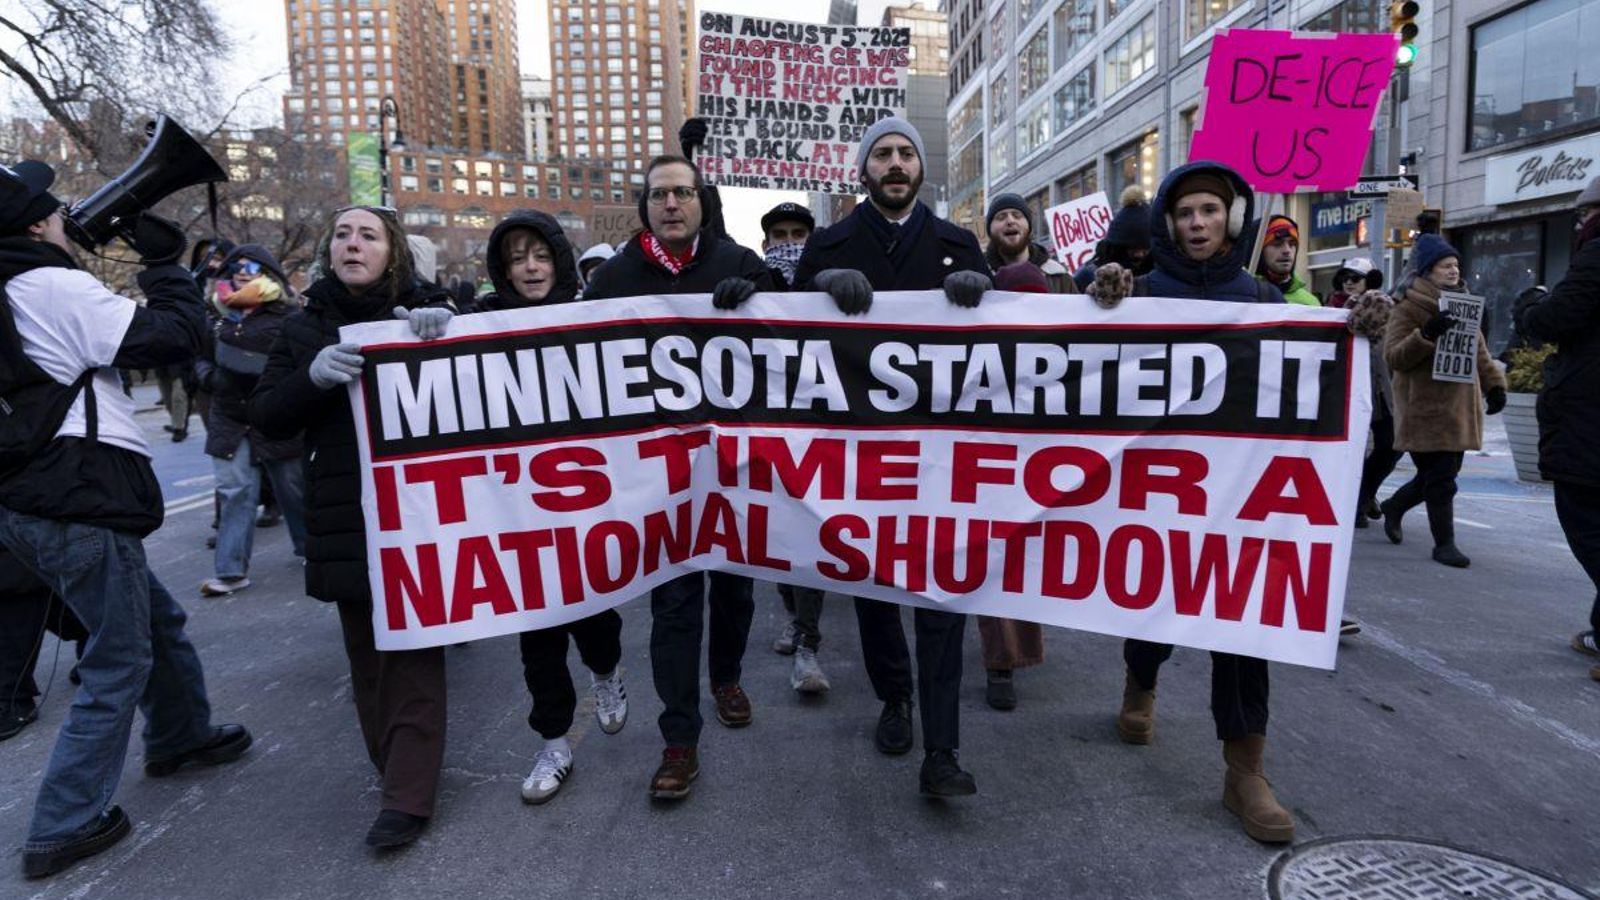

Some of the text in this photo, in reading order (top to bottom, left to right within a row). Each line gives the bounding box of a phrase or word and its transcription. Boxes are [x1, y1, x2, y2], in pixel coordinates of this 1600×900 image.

[701, 12, 733, 34] ON
[740, 17, 838, 45] AUGUST
[700, 34, 825, 66] CHAOFENG
[866, 47, 911, 68] WAS
[700, 53, 898, 87] FOUND HANGING
[1230, 53, 1387, 109] DE-ICE
[700, 72, 725, 95] BY
[729, 74, 777, 98] THE
[851, 87, 906, 109] WITH
[699, 94, 738, 118] HIS
[745, 98, 830, 123] HANDS
[756, 119, 836, 141] BOUND
[697, 136, 739, 159] HIS
[811, 143, 849, 165] AT
[1253, 127, 1329, 180] US
[697, 155, 724, 174] ICE
[731, 156, 845, 182] DETENTION
[704, 173, 769, 189] LAIMING
[773, 177, 833, 193] THAT'S
[1359, 183, 1378, 193] ONE
[594, 213, 637, 231] FUCK
[1316, 206, 1342, 229] five
[1439, 331, 1475, 356] RENEE
[1436, 353, 1473, 376] GOOD
[376, 335, 1337, 441] MINNESOTA STARTED IT
[373, 430, 1338, 532] IT'S TIME FOR A
[380, 492, 1333, 633] NATIONAL SHUTDOWN
